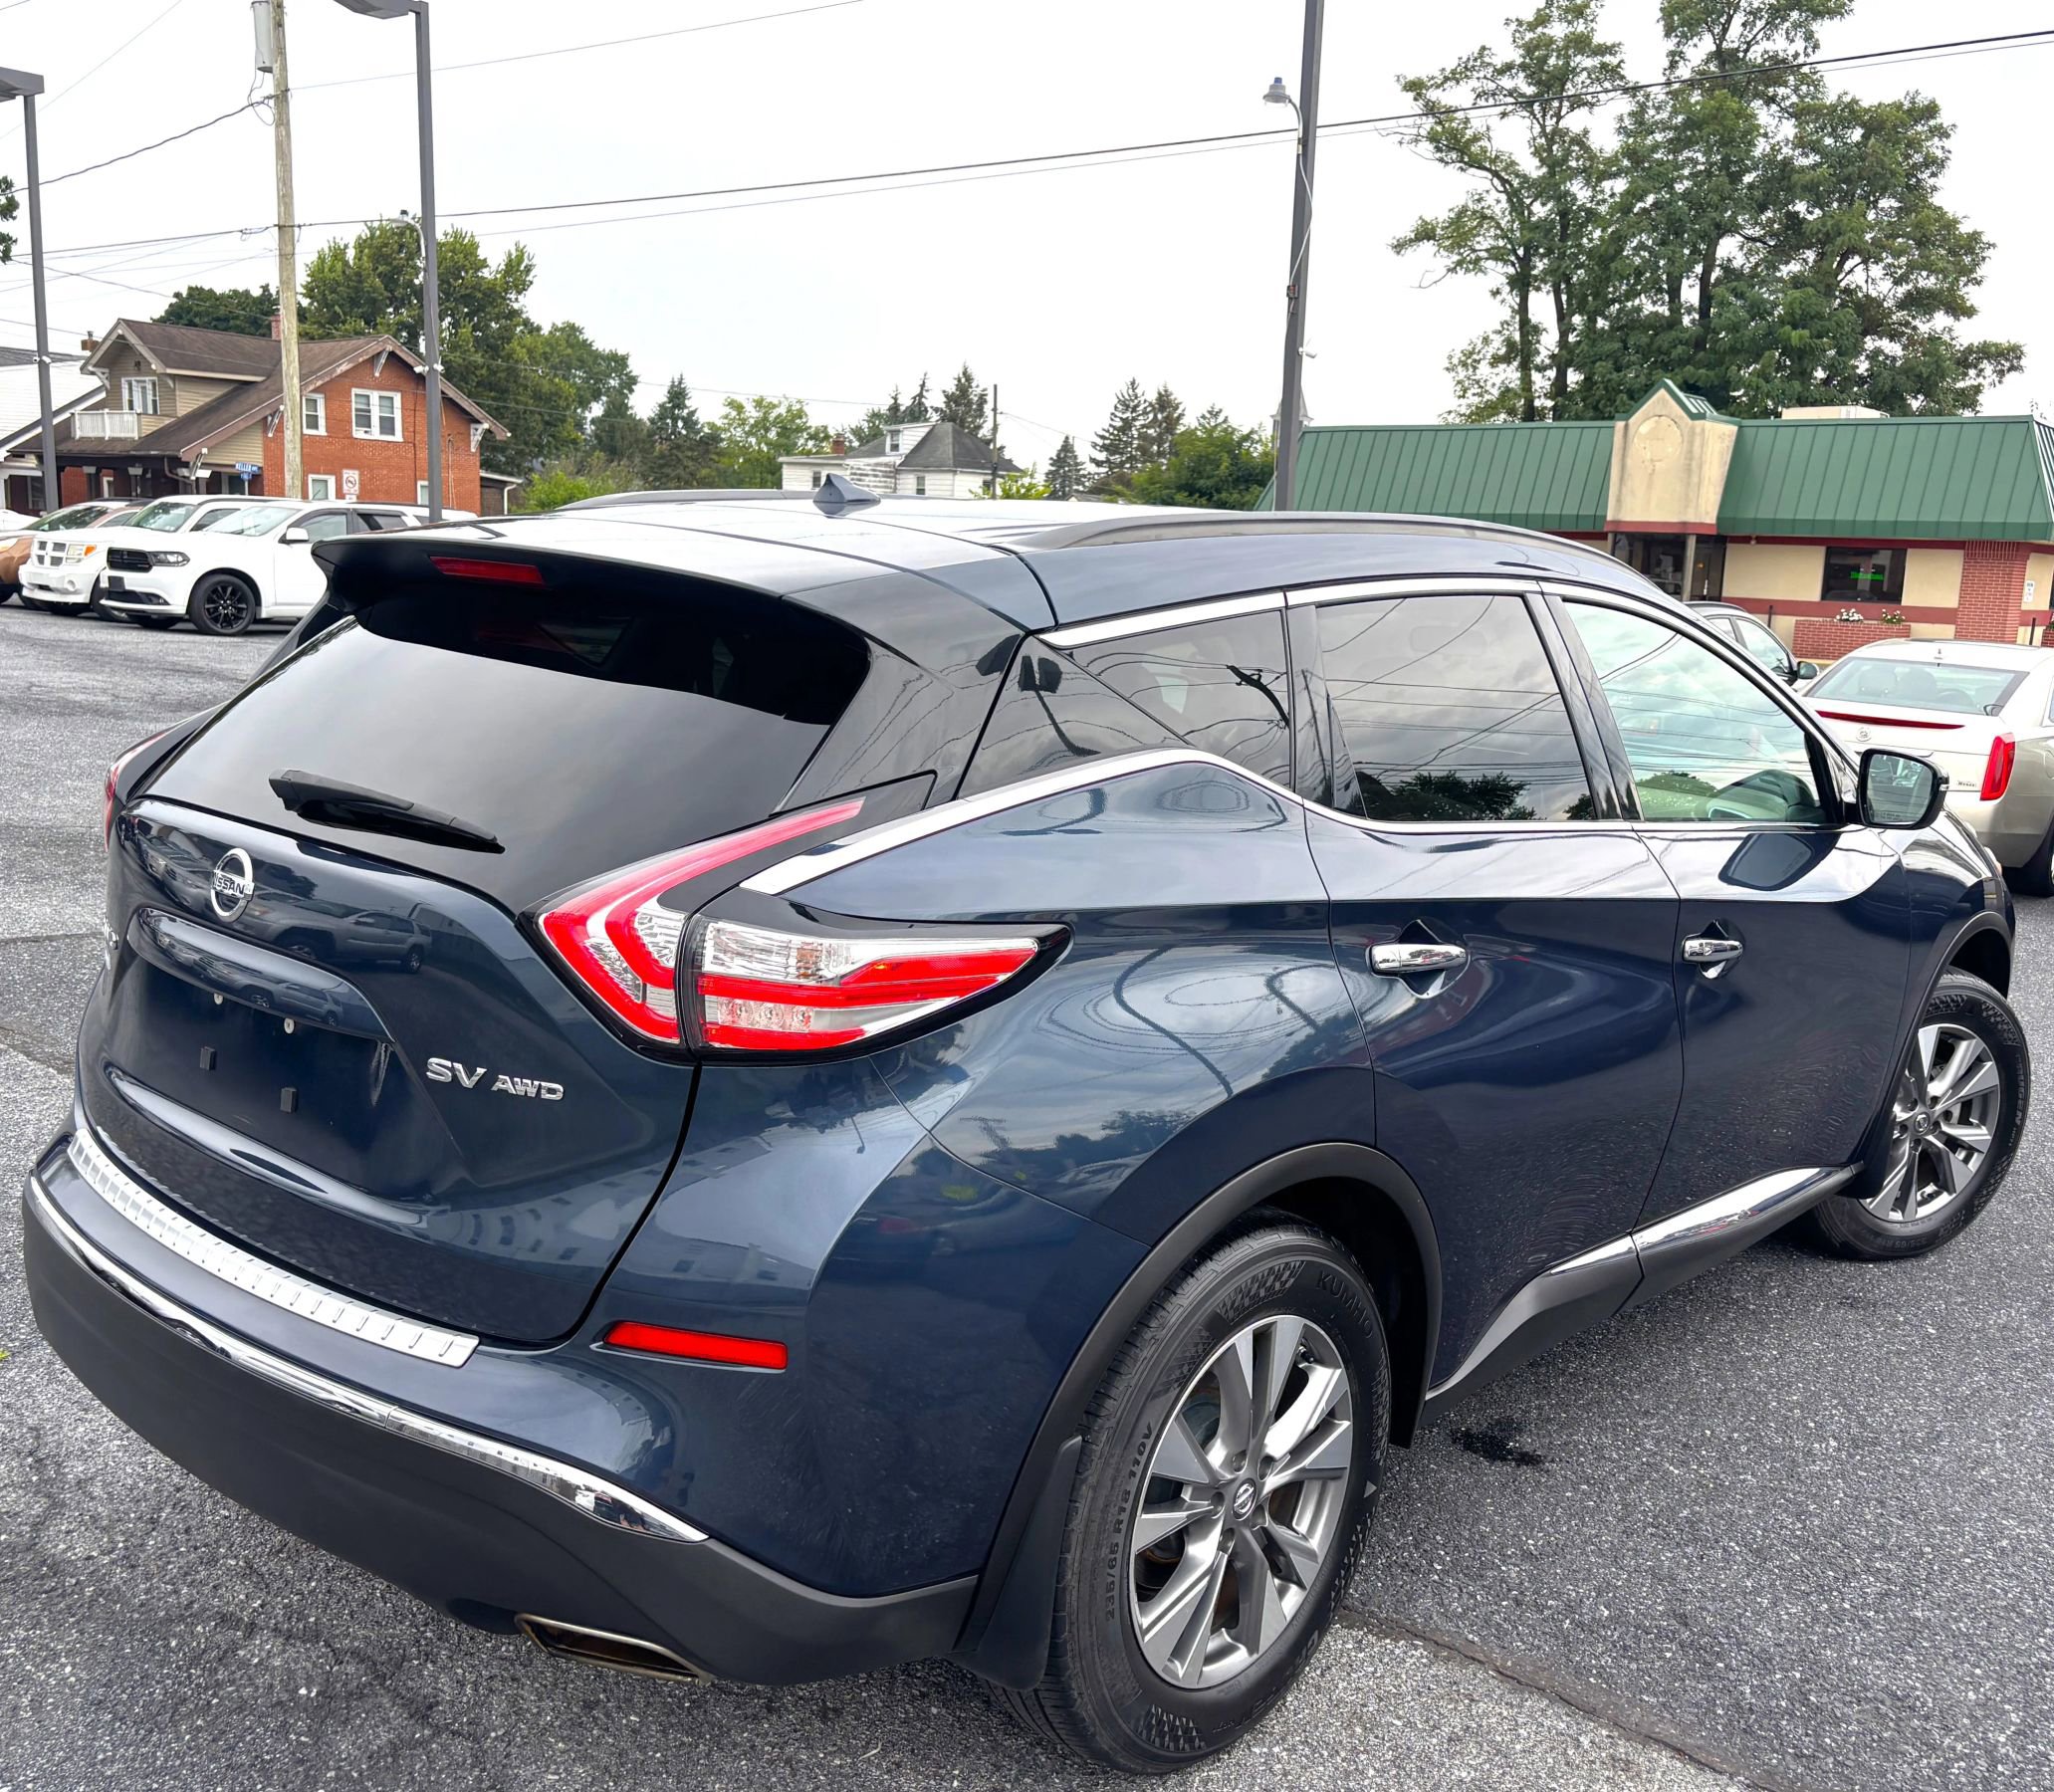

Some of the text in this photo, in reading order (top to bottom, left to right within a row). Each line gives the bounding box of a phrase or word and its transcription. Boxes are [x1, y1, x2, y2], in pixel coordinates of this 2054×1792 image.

[425, 1057, 564, 1101] SV AWD
[1315, 1269, 1374, 1339] KUMHO
[1113, 1488, 1131, 1534] R18
[1128, 1421, 1153, 1480] 110V
